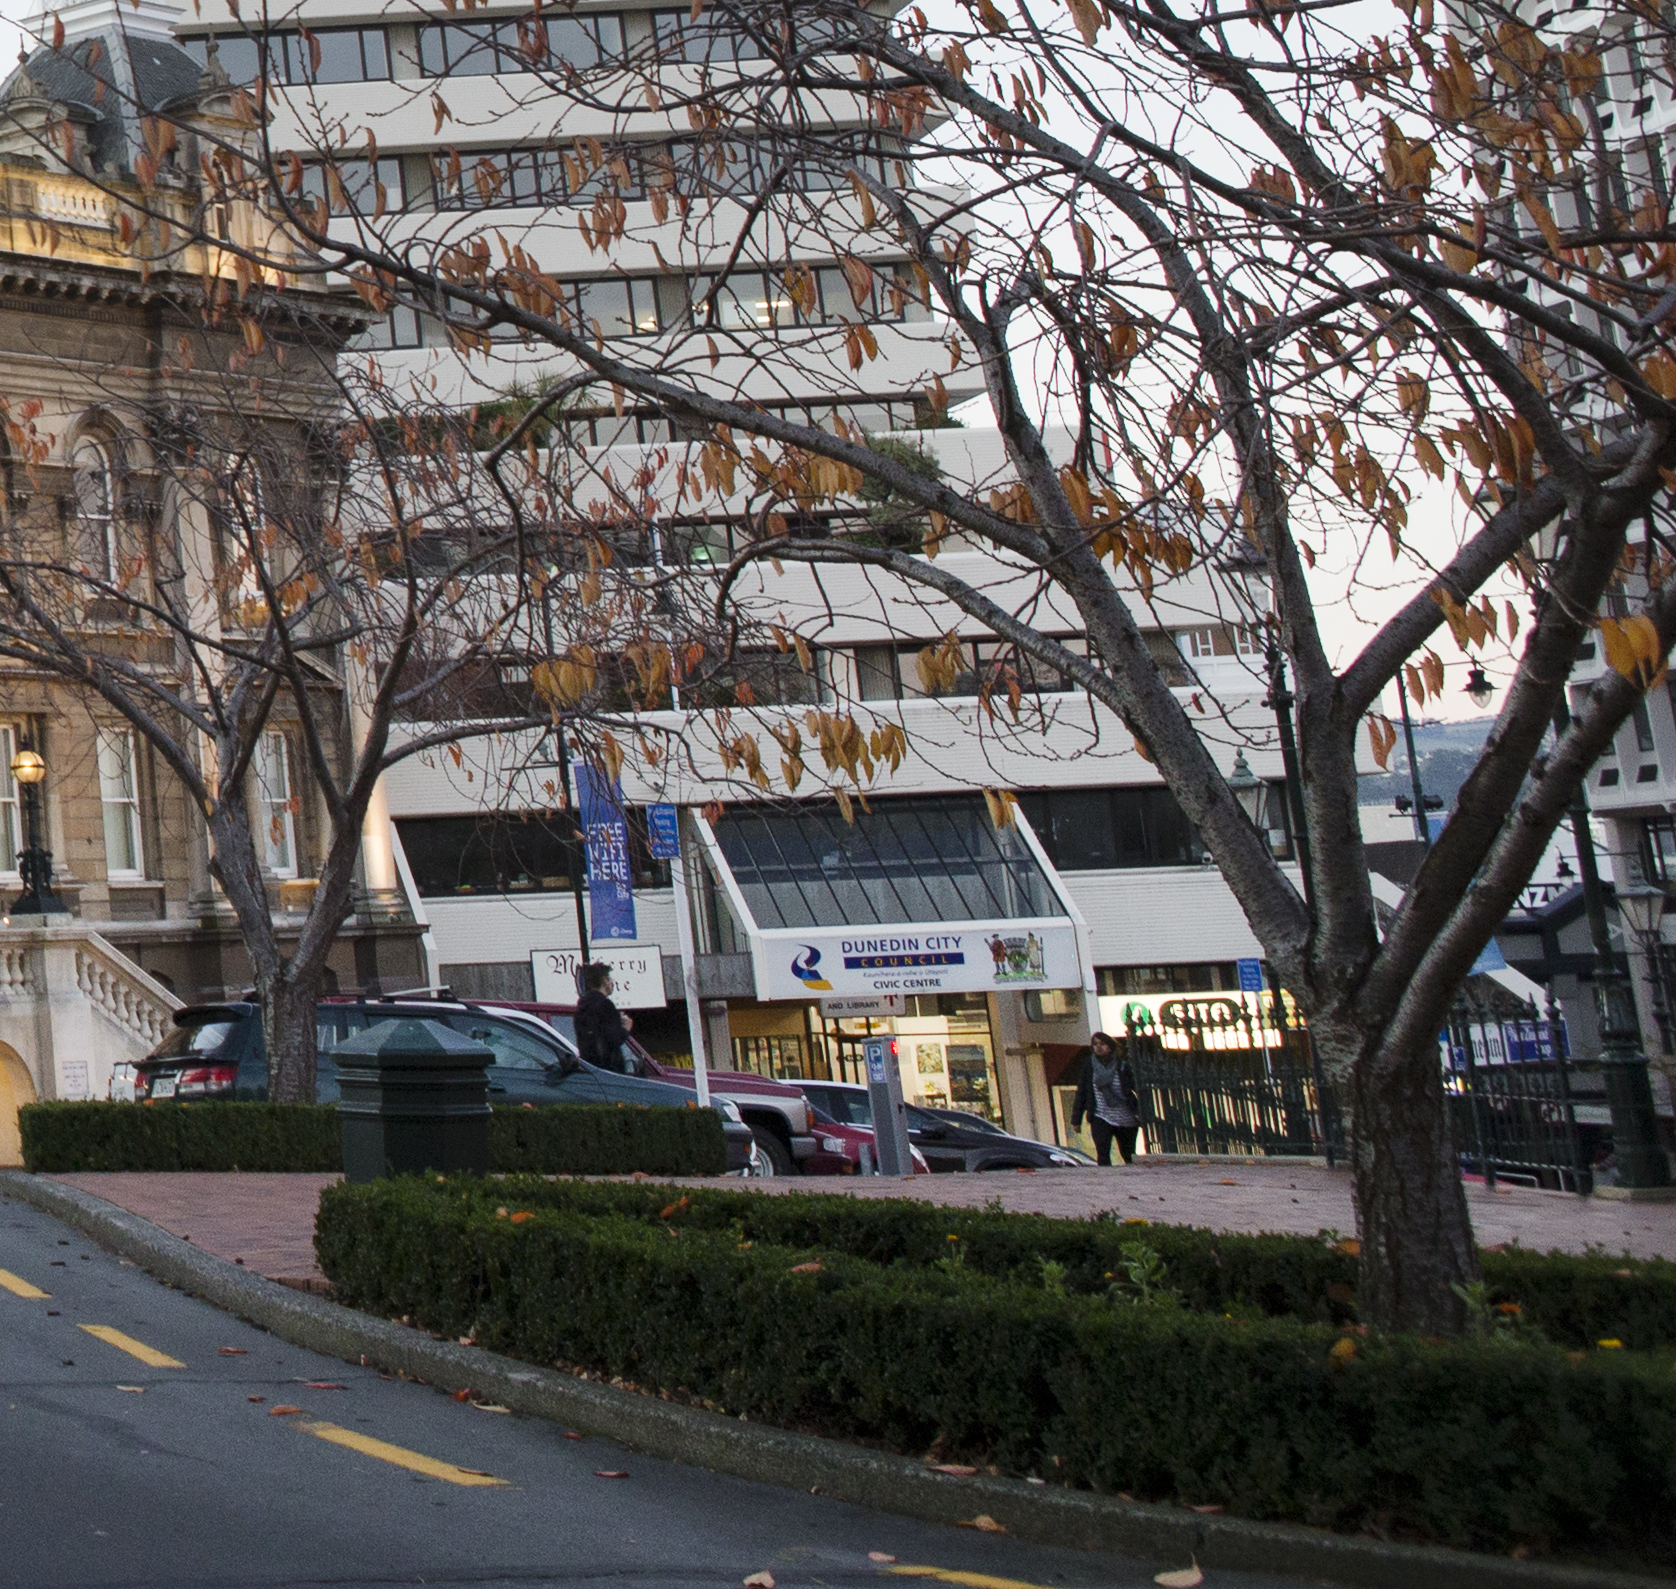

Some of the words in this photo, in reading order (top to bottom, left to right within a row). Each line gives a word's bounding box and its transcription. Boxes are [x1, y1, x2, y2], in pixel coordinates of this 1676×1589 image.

[590, 861, 628, 881] HERE
[841, 938, 919, 953] DUNEDIN
[926, 936, 962, 950] CITY
[860, 955, 950, 968] COUNCIL
[873, 981, 900, 989] CIVIC
[903, 979, 941, 988] CENTRE
[847, 1001, 880, 1009] LIBRARY
[869, 1047, 881, 1062] P
